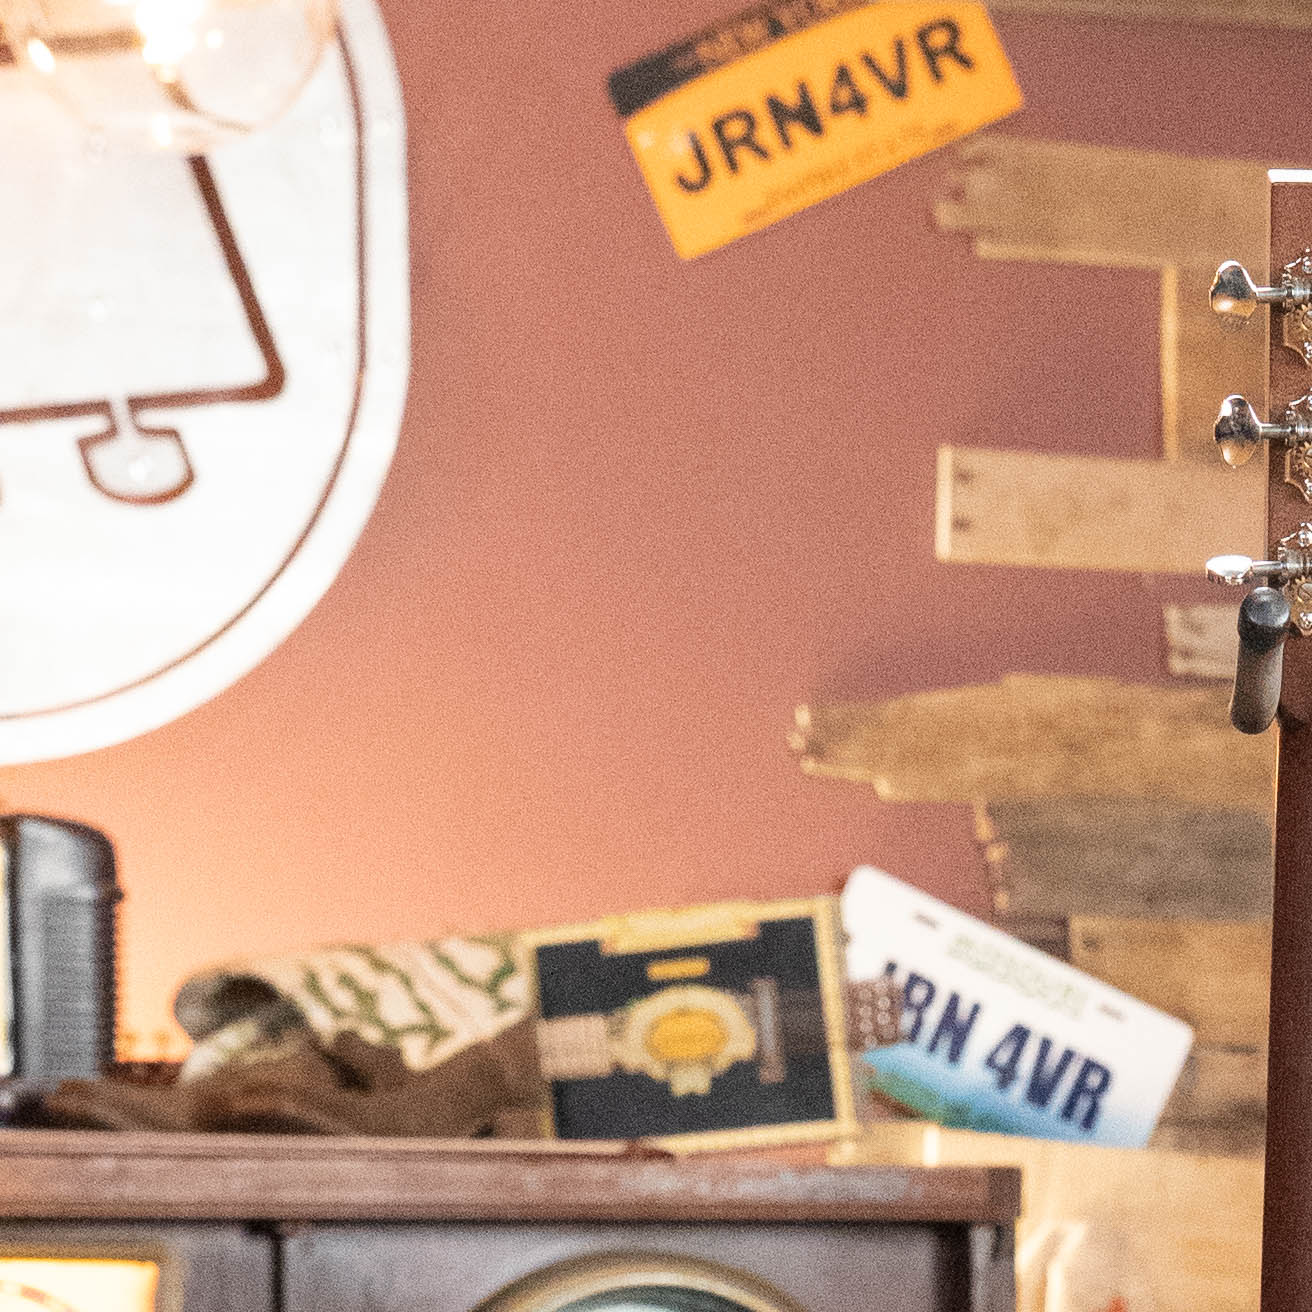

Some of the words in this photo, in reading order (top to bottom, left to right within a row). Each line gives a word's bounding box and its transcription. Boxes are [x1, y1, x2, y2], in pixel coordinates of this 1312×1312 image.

[675, 16, 975, 193] JRN4VR
[884, 958, 982, 1066] RN
[984, 1022, 1114, 1132] 4VR
